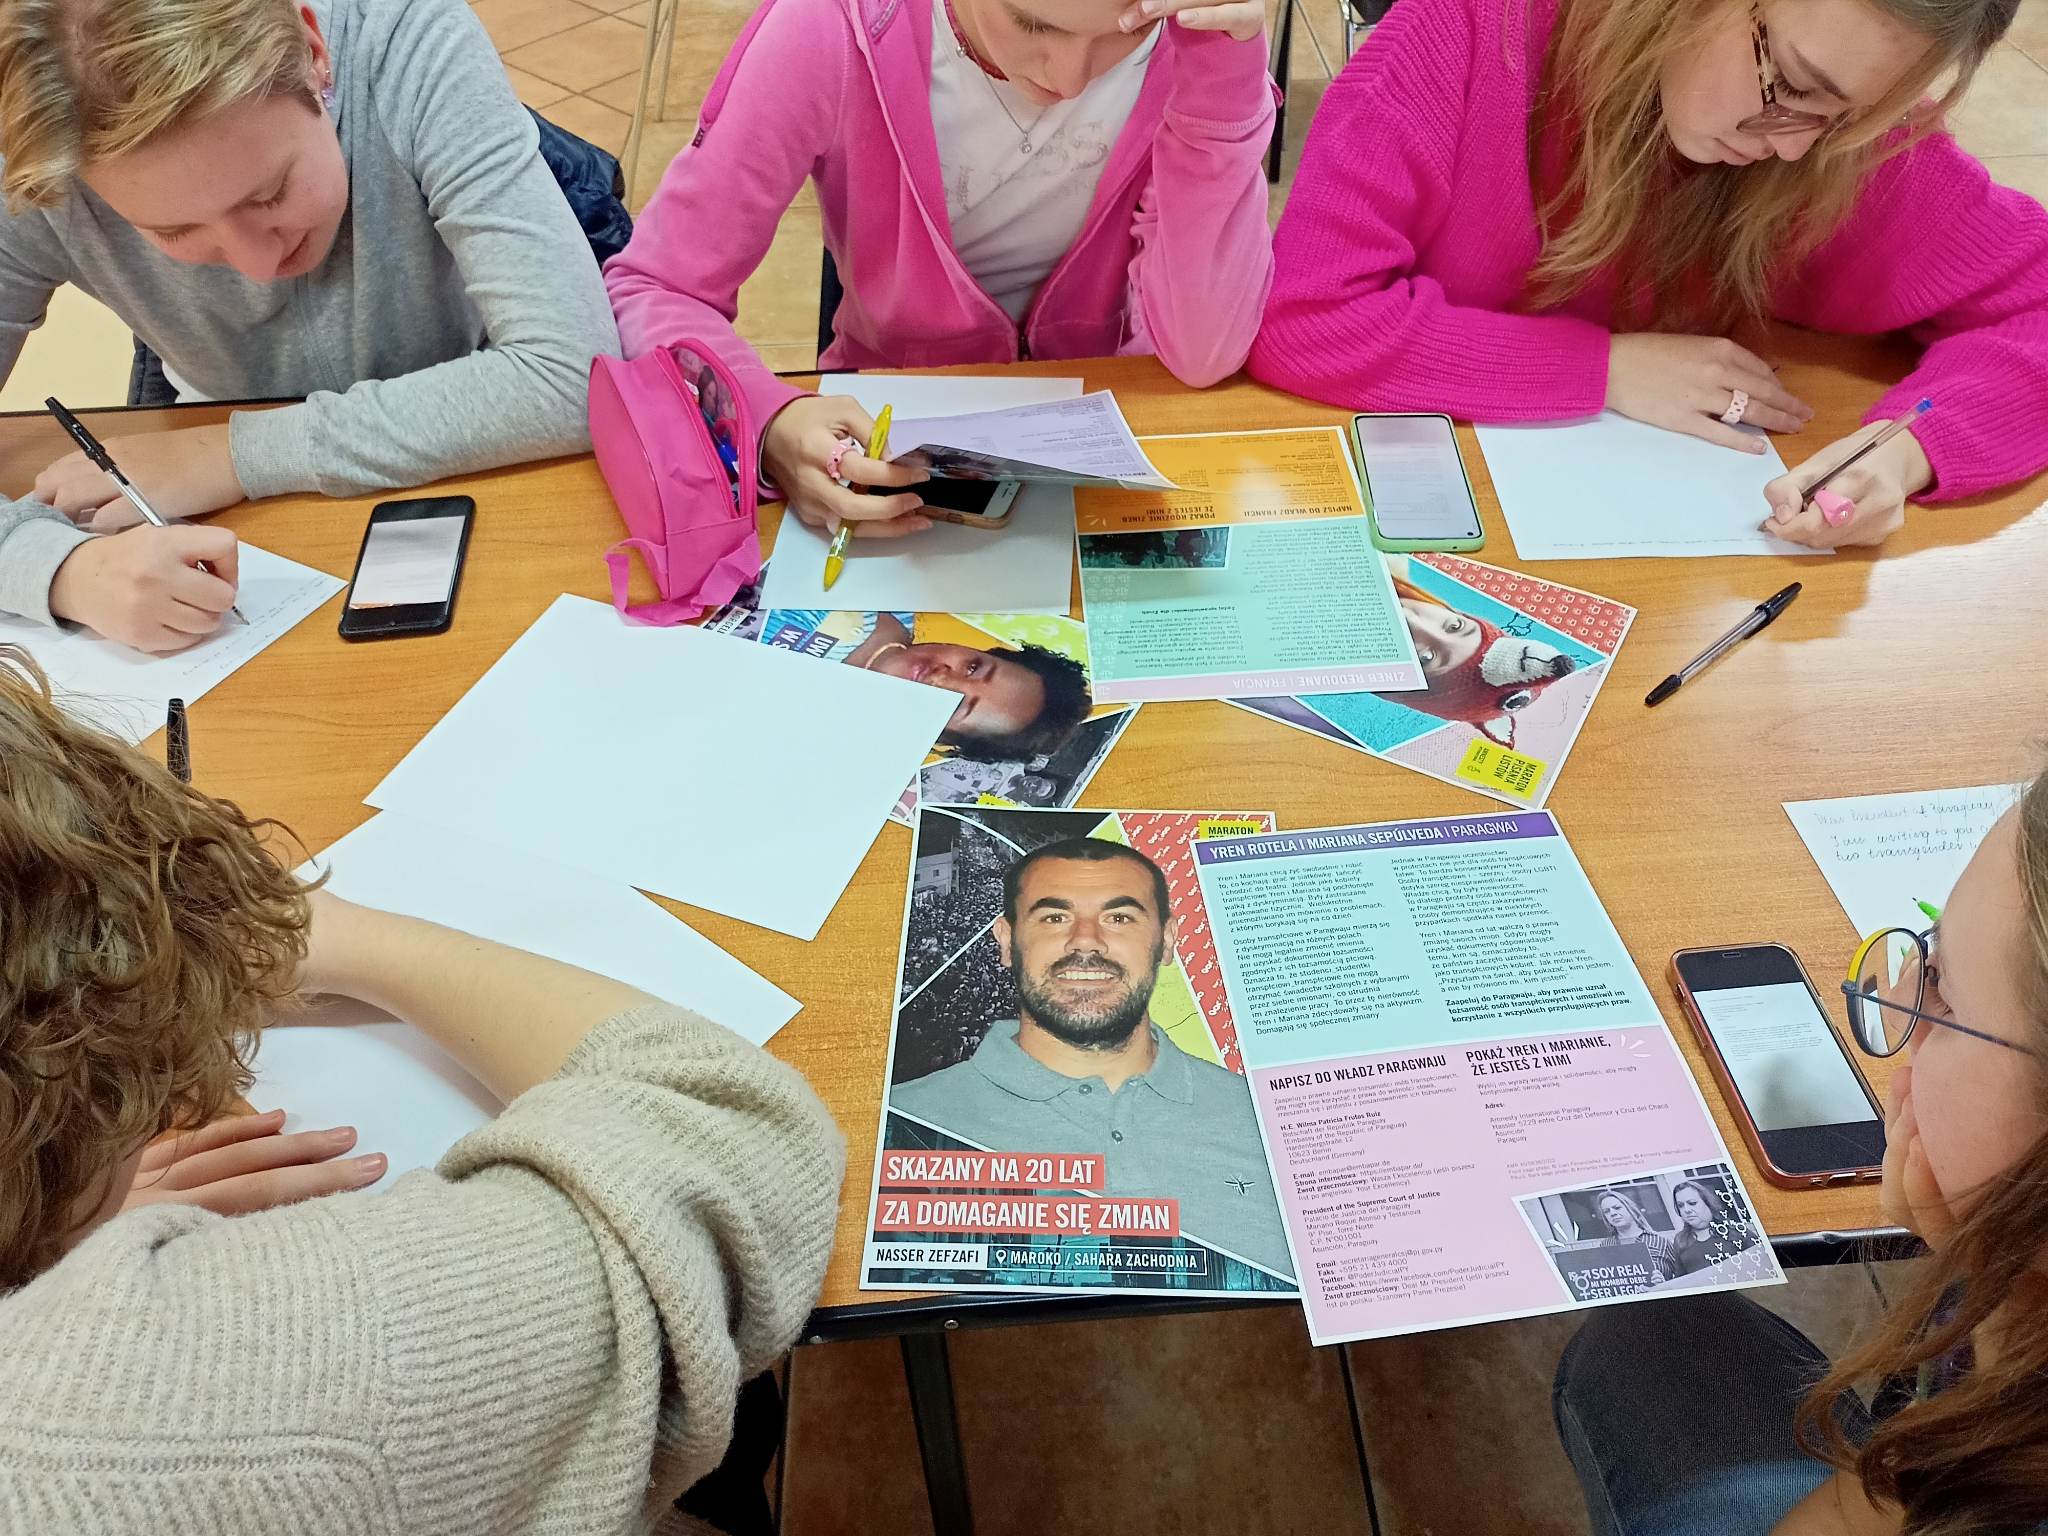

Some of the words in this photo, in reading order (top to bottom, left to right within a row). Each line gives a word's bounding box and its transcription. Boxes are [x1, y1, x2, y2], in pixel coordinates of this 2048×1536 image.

[1233, 676, 1288, 689] FRANCJA
[1299, 673, 1365, 688] REDOUANE
[1367, 672, 1406, 682] ZINEB
[1514, 762, 1537, 792] MARATON
[1208, 826, 1254, 835] MARATON
[1210, 844, 1246, 860] YREN
[1248, 840, 1297, 856] ROTELA
[1306, 834, 1366, 850] MARIANA
[1368, 826, 1444, 844] SEPÚLVEDA
[1451, 820, 1518, 838] PARAGWAJ
[1466, 1045, 1506, 1062] POKAŻ
[1507, 1043, 1539, 1058] YREN
[1541, 1042, 1547, 1053] I
[1549, 1036, 1611, 1052] MARIANIE,
[1270, 1074, 1312, 1090] NAPISZ
[1314, 1071, 1332, 1084] DO
[1334, 1066, 1375, 1080] WŁADZ
[1376, 1054, 1446, 1075] PARAGWAJU
[1471, 1063, 1488, 1076] ŻE
[1490, 1057, 1530, 1074] JESTEŚ
[1532, 1057, 1542, 1068] Z
[1543, 1054, 1572, 1067] NIMI
[886, 1156, 985, 1182] SKAZANY
[990, 1158, 1020, 1183] NA
[1025, 1158, 1053, 1184] 20
[1058, 1159, 1095, 1184] LAT
[1302, 1205, 1334, 1215] President
[1356, 1197, 1387, 1209] Supreme
[1387, 1194, 1407, 1202] Court
[1416, 1190, 1440, 1198] Justice
[881, 1200, 910, 1226] ZA
[916, 1201, 1049, 1228] DOMAGANIE
[1055, 1203, 1092, 1234] SIĘ
[1098, 1204, 1170, 1230] ZMIAN
[876, 1248, 924, 1262] NASSER
[928, 1250, 980, 1263] ZEFZAFI
[1010, 1252, 1062, 1266] MAROKO
[1074, 1252, 1122, 1267] SAHARA
[1126, 1253, 1198, 1268] ZACHODNIA
[1590, 1266, 1615, 1280] SOY
[1616, 1263, 1648, 1277] REAL
[1590, 1280, 1600, 1288] MI
[1600, 1278, 1630, 1287] NOMBRE
[1630, 1276, 1648, 1284] DEBE
[1591, 1288, 1612, 1299] SER
[1614, 1285, 1641, 1297] LEGA
